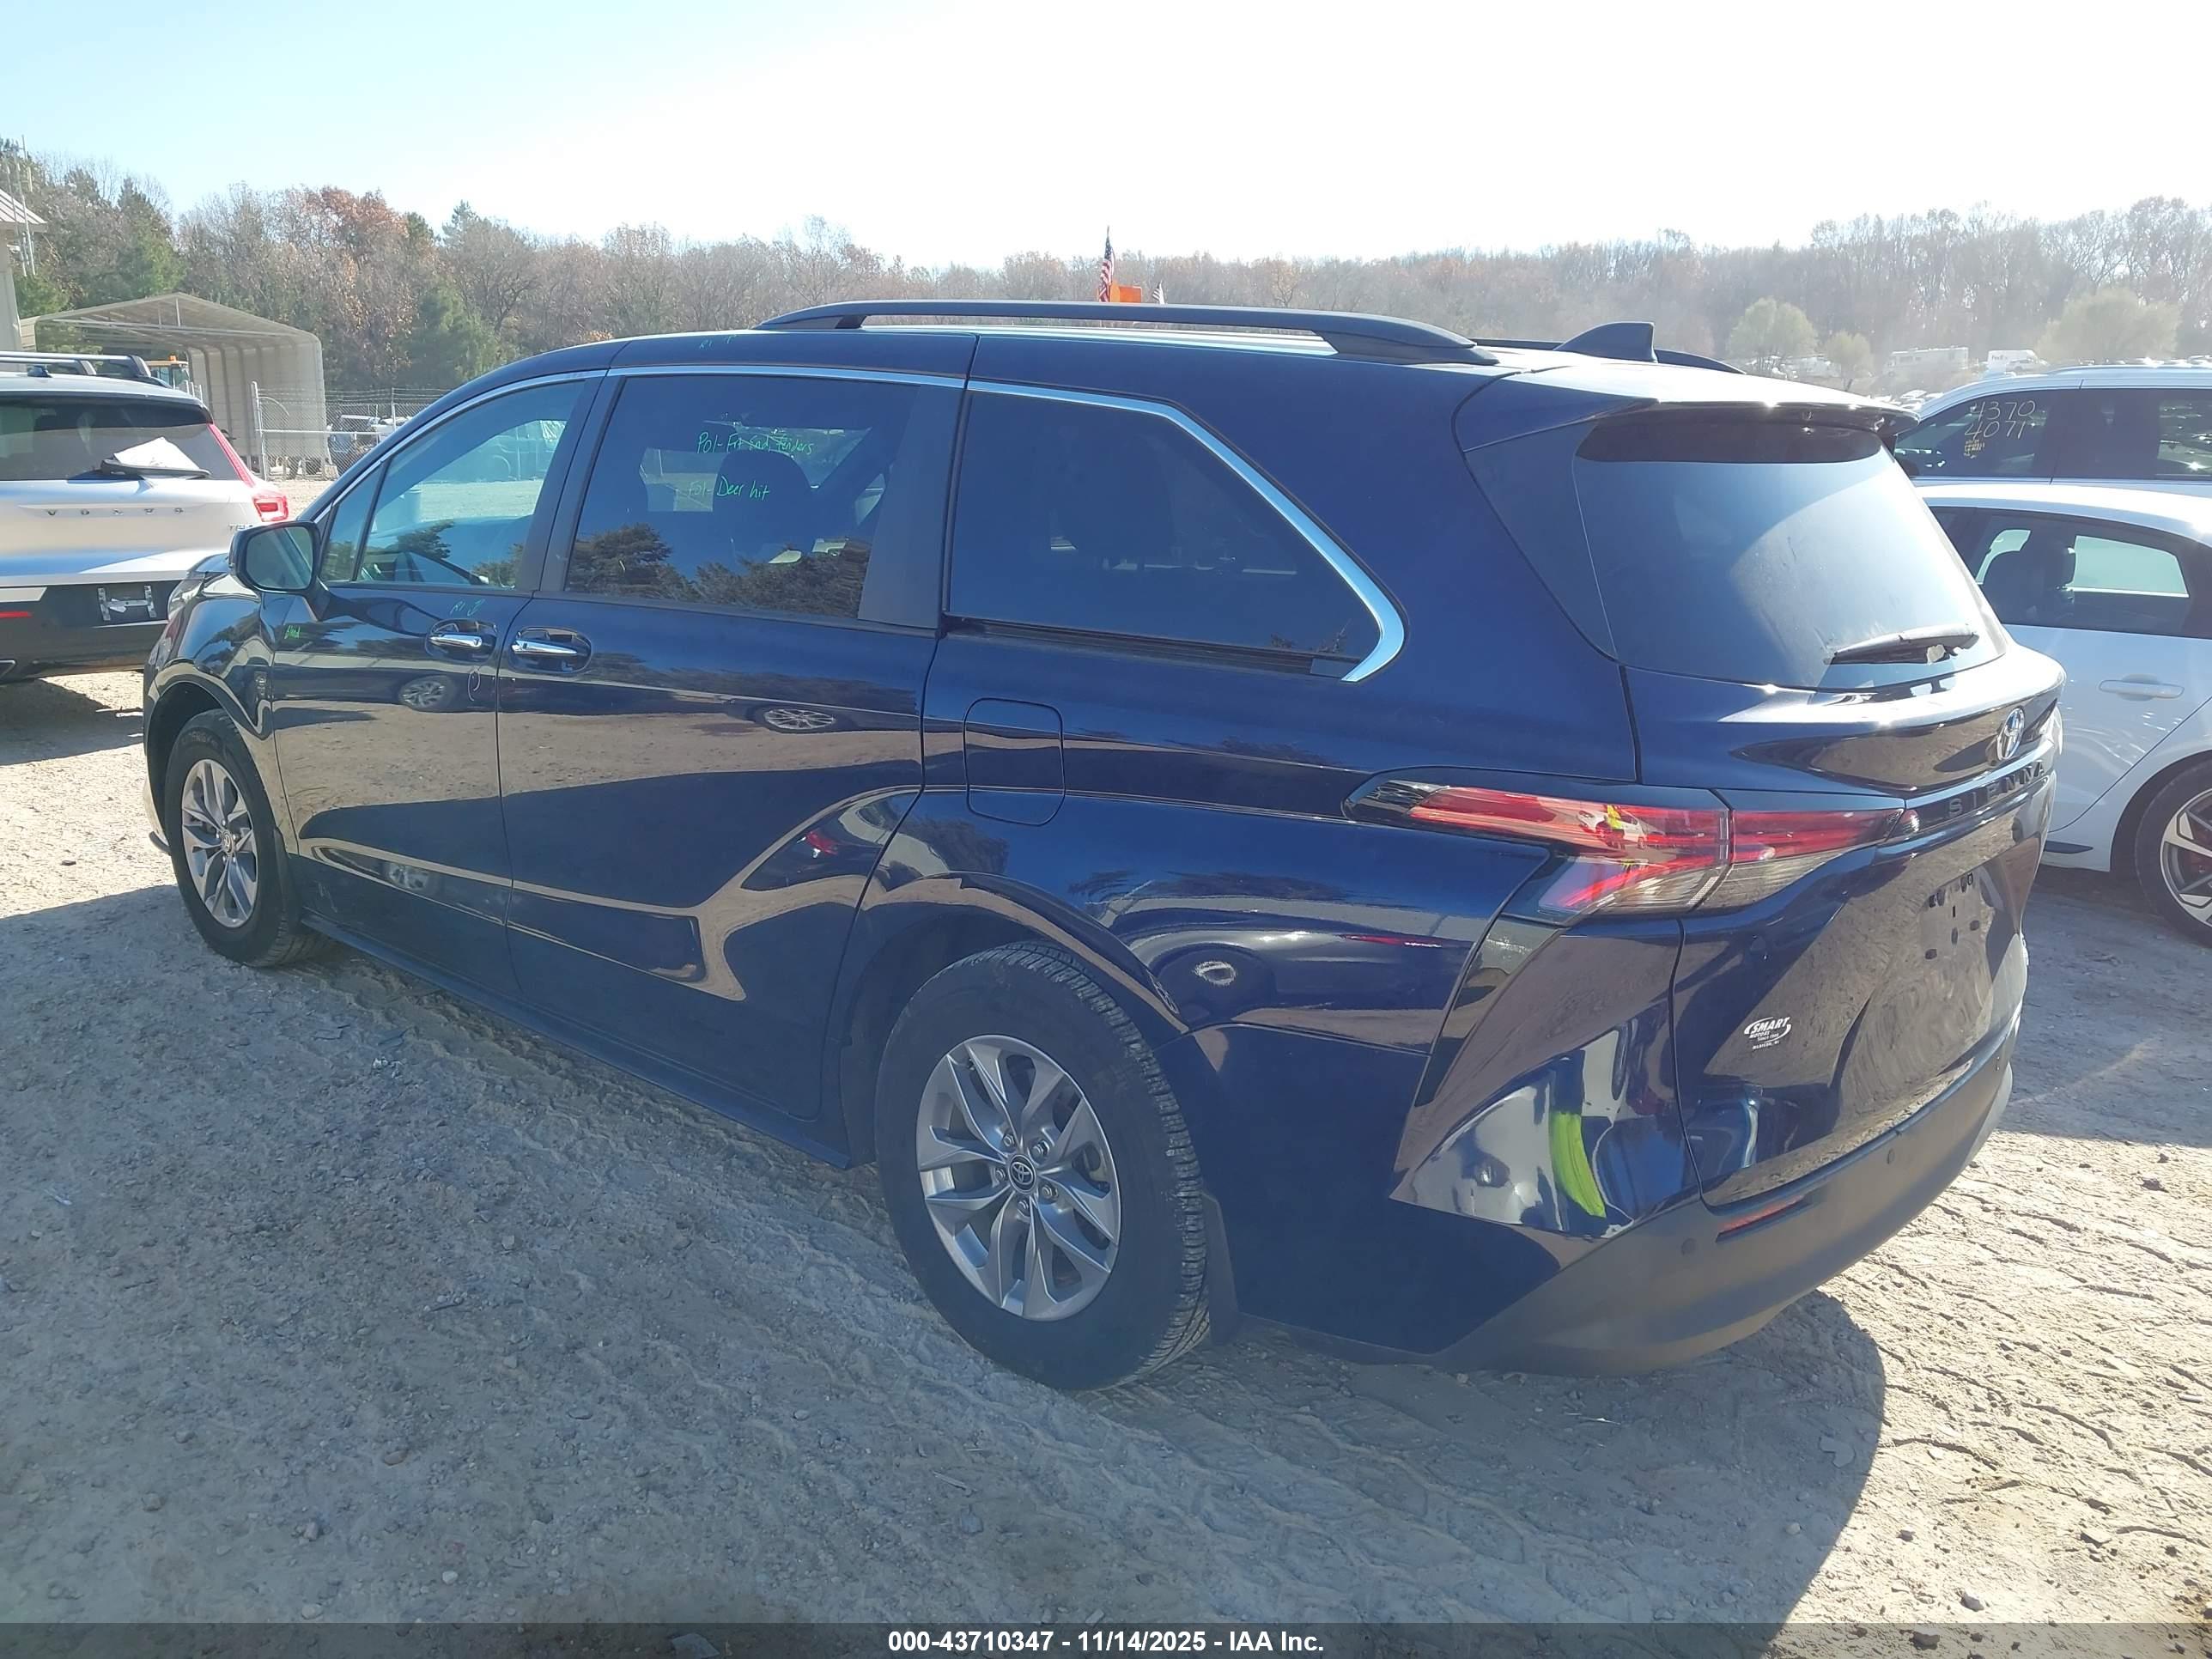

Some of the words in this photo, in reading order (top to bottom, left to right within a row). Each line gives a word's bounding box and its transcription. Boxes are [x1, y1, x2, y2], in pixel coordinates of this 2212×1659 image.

[1969, 400, 2036, 422] 4370
[1965, 420, 2027, 440] 4071
[716, 475, 745, 496] Deer
[749, 480, 770, 500] hit
[46, 507, 185, 516] VOLVO
[1948, 759, 2045, 817] SIENNA
[1751, 1017, 1791, 1034] SMART
